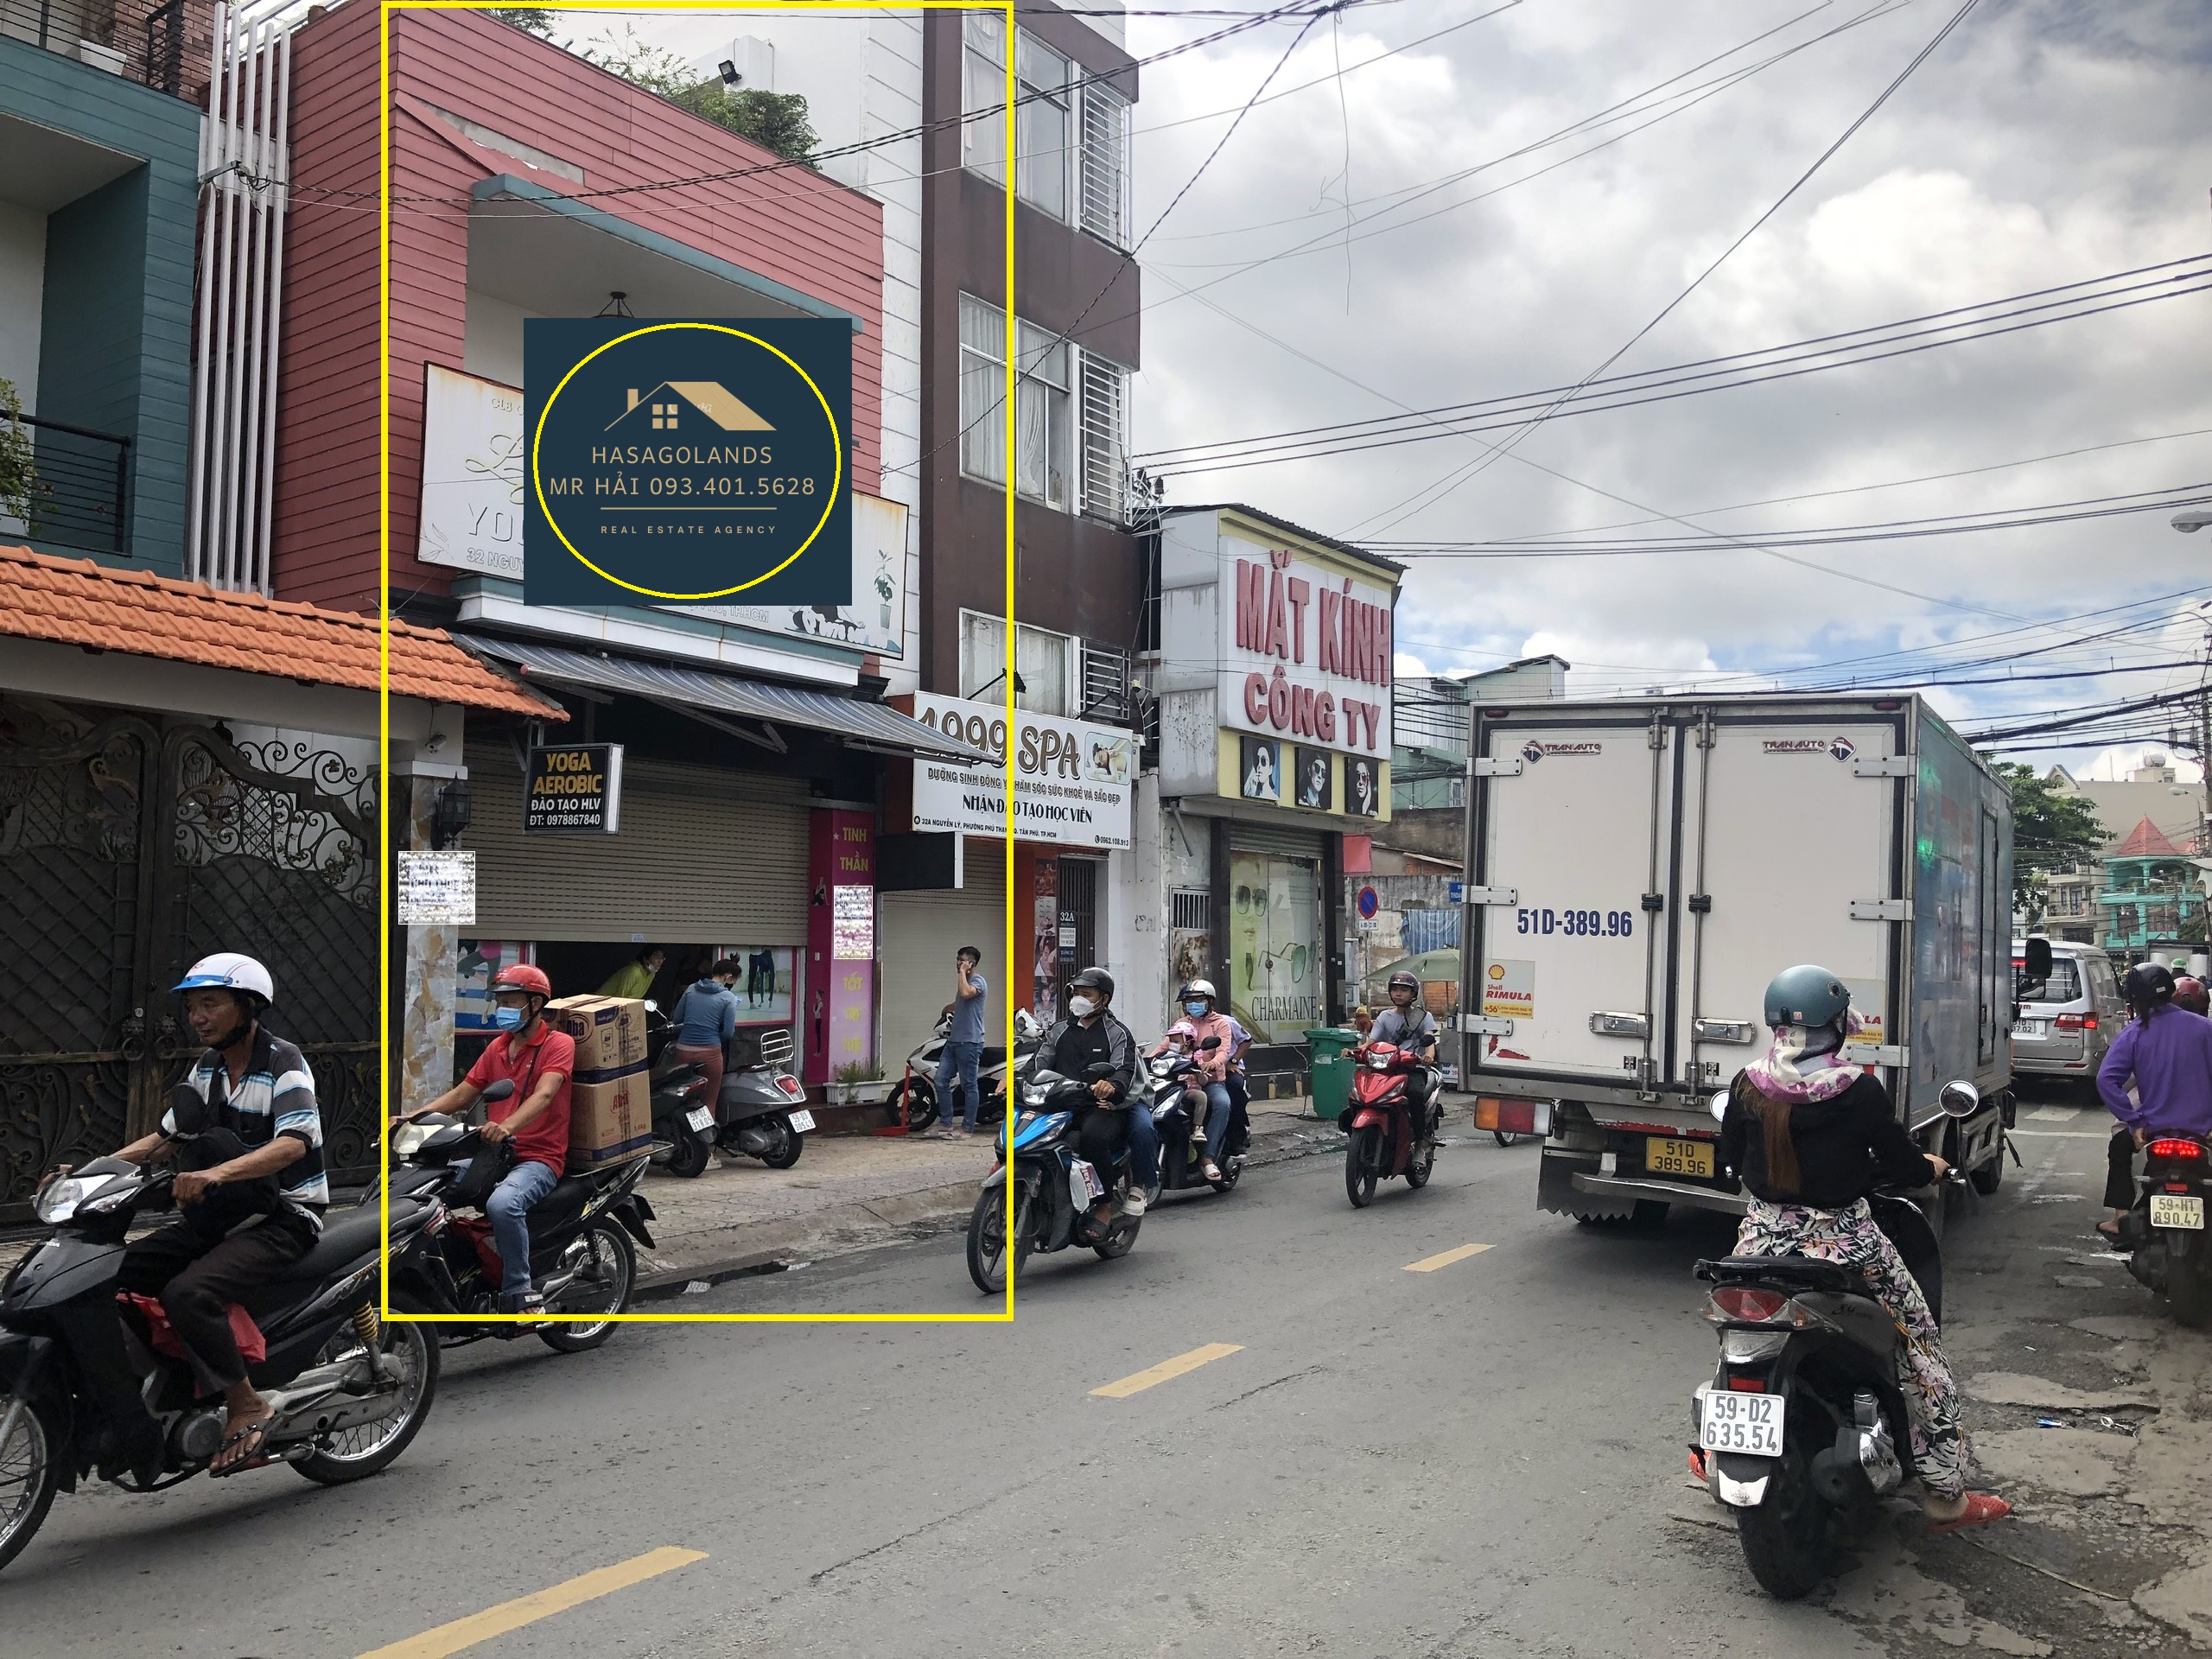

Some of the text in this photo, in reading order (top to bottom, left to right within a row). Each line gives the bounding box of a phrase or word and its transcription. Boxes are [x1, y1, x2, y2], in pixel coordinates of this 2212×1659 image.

[467, 547, 484, 565] 32
[1319, 577, 1389, 687] KÍNH
[1244, 665, 1382, 750] CÔNG TY
[546, 752, 592, 772] YOGA
[1018, 725, 1081, 780] SPA
[532, 774, 603, 794] AEROBIC
[959, 772, 979, 785] SINH
[531, 796, 601, 813] ĐÀO TẠO HLV
[963, 794, 995, 814] NHẬN
[1023, 802, 1044, 820] TẠO
[1046, 805, 1068, 823] HỌC
[530, 814, 601, 826] ĐT: 0978867840
[842, 827, 867, 842] TINH
[840, 850, 868, 872] THẦN
[1059, 912, 1075, 922] 32A
[1517, 909, 1632, 937] 51D-389.96
[1485, 991, 1532, 1001] RIMULA
[1252, 996, 1318, 1021] CHARMAINE
[1666, 1142, 1694, 1158] 51D
[1654, 1155, 1706, 1174] 389.96
[2154, 1211, 2201, 1227] 890.47
[1714, 1395, 1772, 1423] 59-D2
[1706, 1421, 1777, 1452] 635.54
